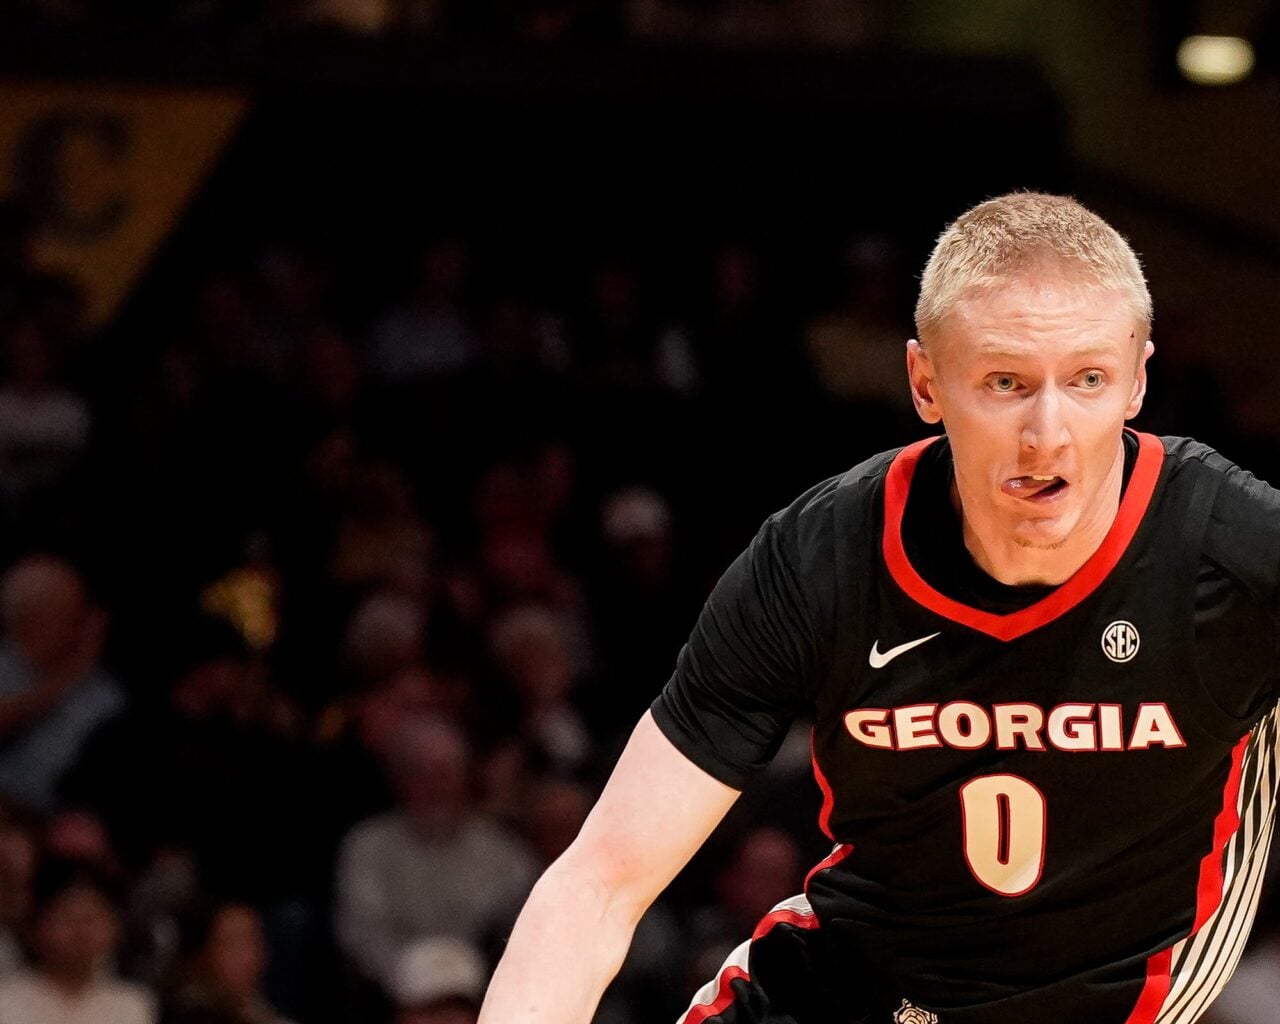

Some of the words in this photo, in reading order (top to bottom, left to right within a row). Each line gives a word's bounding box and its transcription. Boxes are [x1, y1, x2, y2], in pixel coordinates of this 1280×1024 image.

[1105, 624, 1136, 658] SEC
[843, 701, 1187, 753] GEORGIA
[960, 773, 1047, 897] 0
